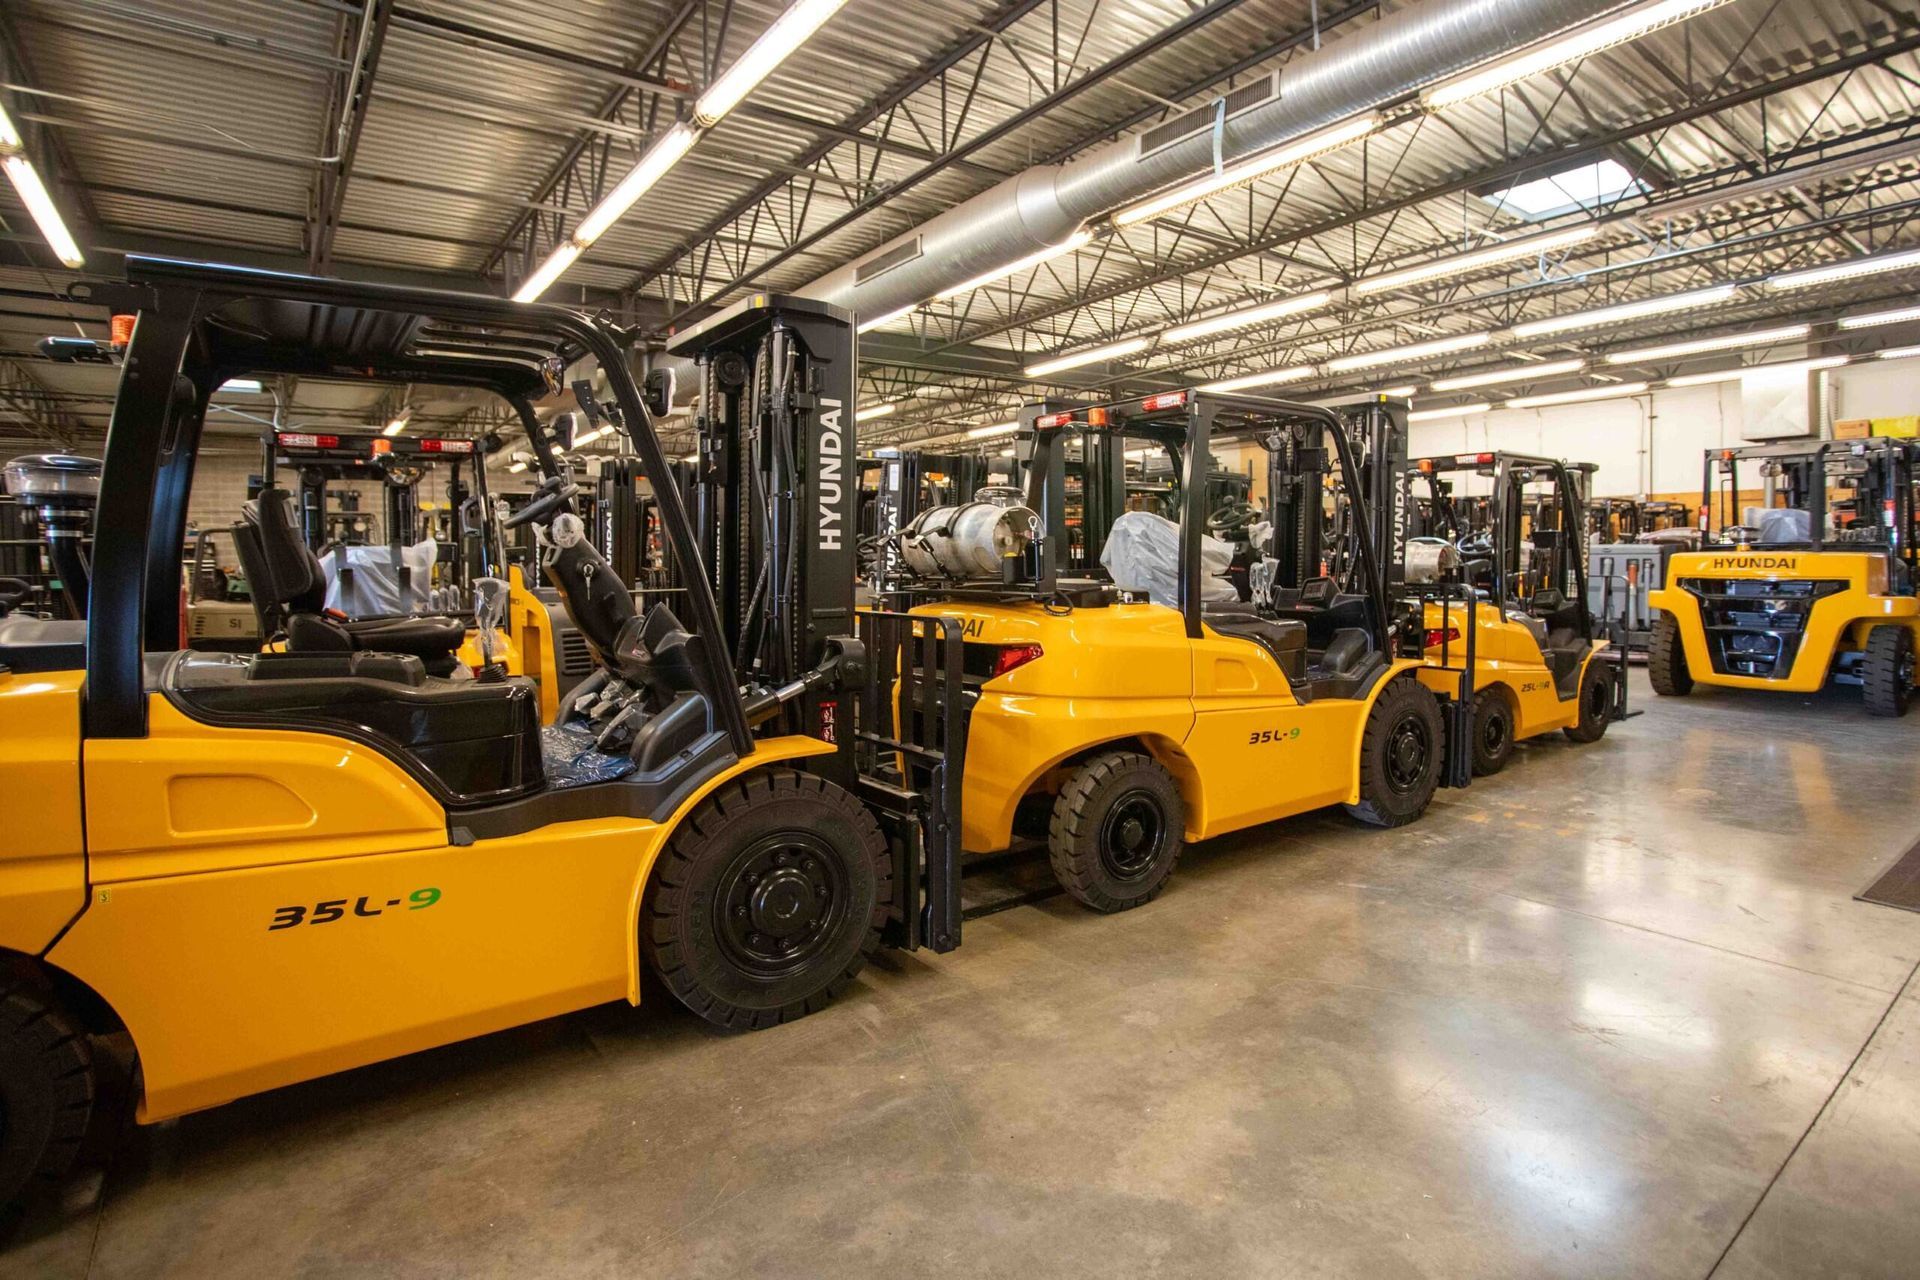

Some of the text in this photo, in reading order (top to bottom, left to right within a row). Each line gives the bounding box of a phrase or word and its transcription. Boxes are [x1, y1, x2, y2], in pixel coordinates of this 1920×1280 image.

[820, 398, 842, 550] HYUNDAI
[1393, 471, 1405, 565] HYUNDAI
[1714, 557, 1796, 569] HYUNDAI
[1249, 727, 1300, 744] 35L-9
[268, 887, 441, 931] 35L-9
